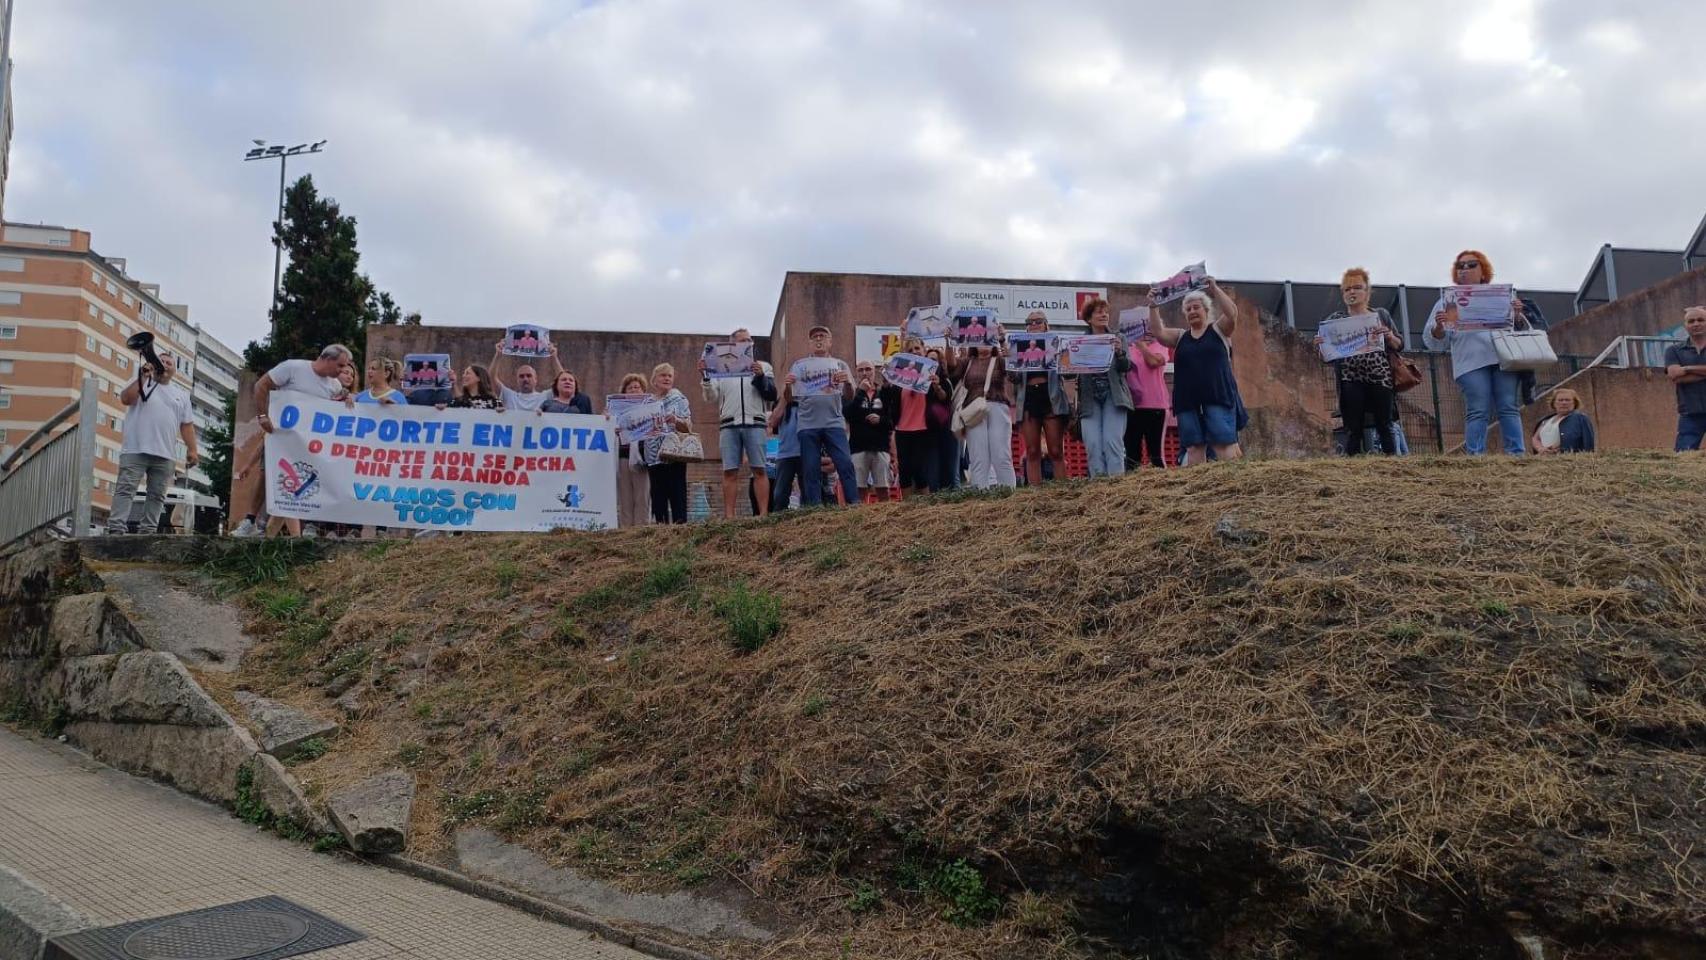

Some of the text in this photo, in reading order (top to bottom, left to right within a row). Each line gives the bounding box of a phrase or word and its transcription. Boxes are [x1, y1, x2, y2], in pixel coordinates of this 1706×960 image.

[1017, 299, 1070, 310] ALCALDÍA
[280, 405, 609, 453] O DEPORTE EN LOITA
[308, 439, 576, 472] O DEPORTE NON SE PECHA
[354, 461, 530, 486] NIN SE ABANDOA
[353, 482, 517, 511] VAMOS CON
[394, 504, 475, 526] TODO!
